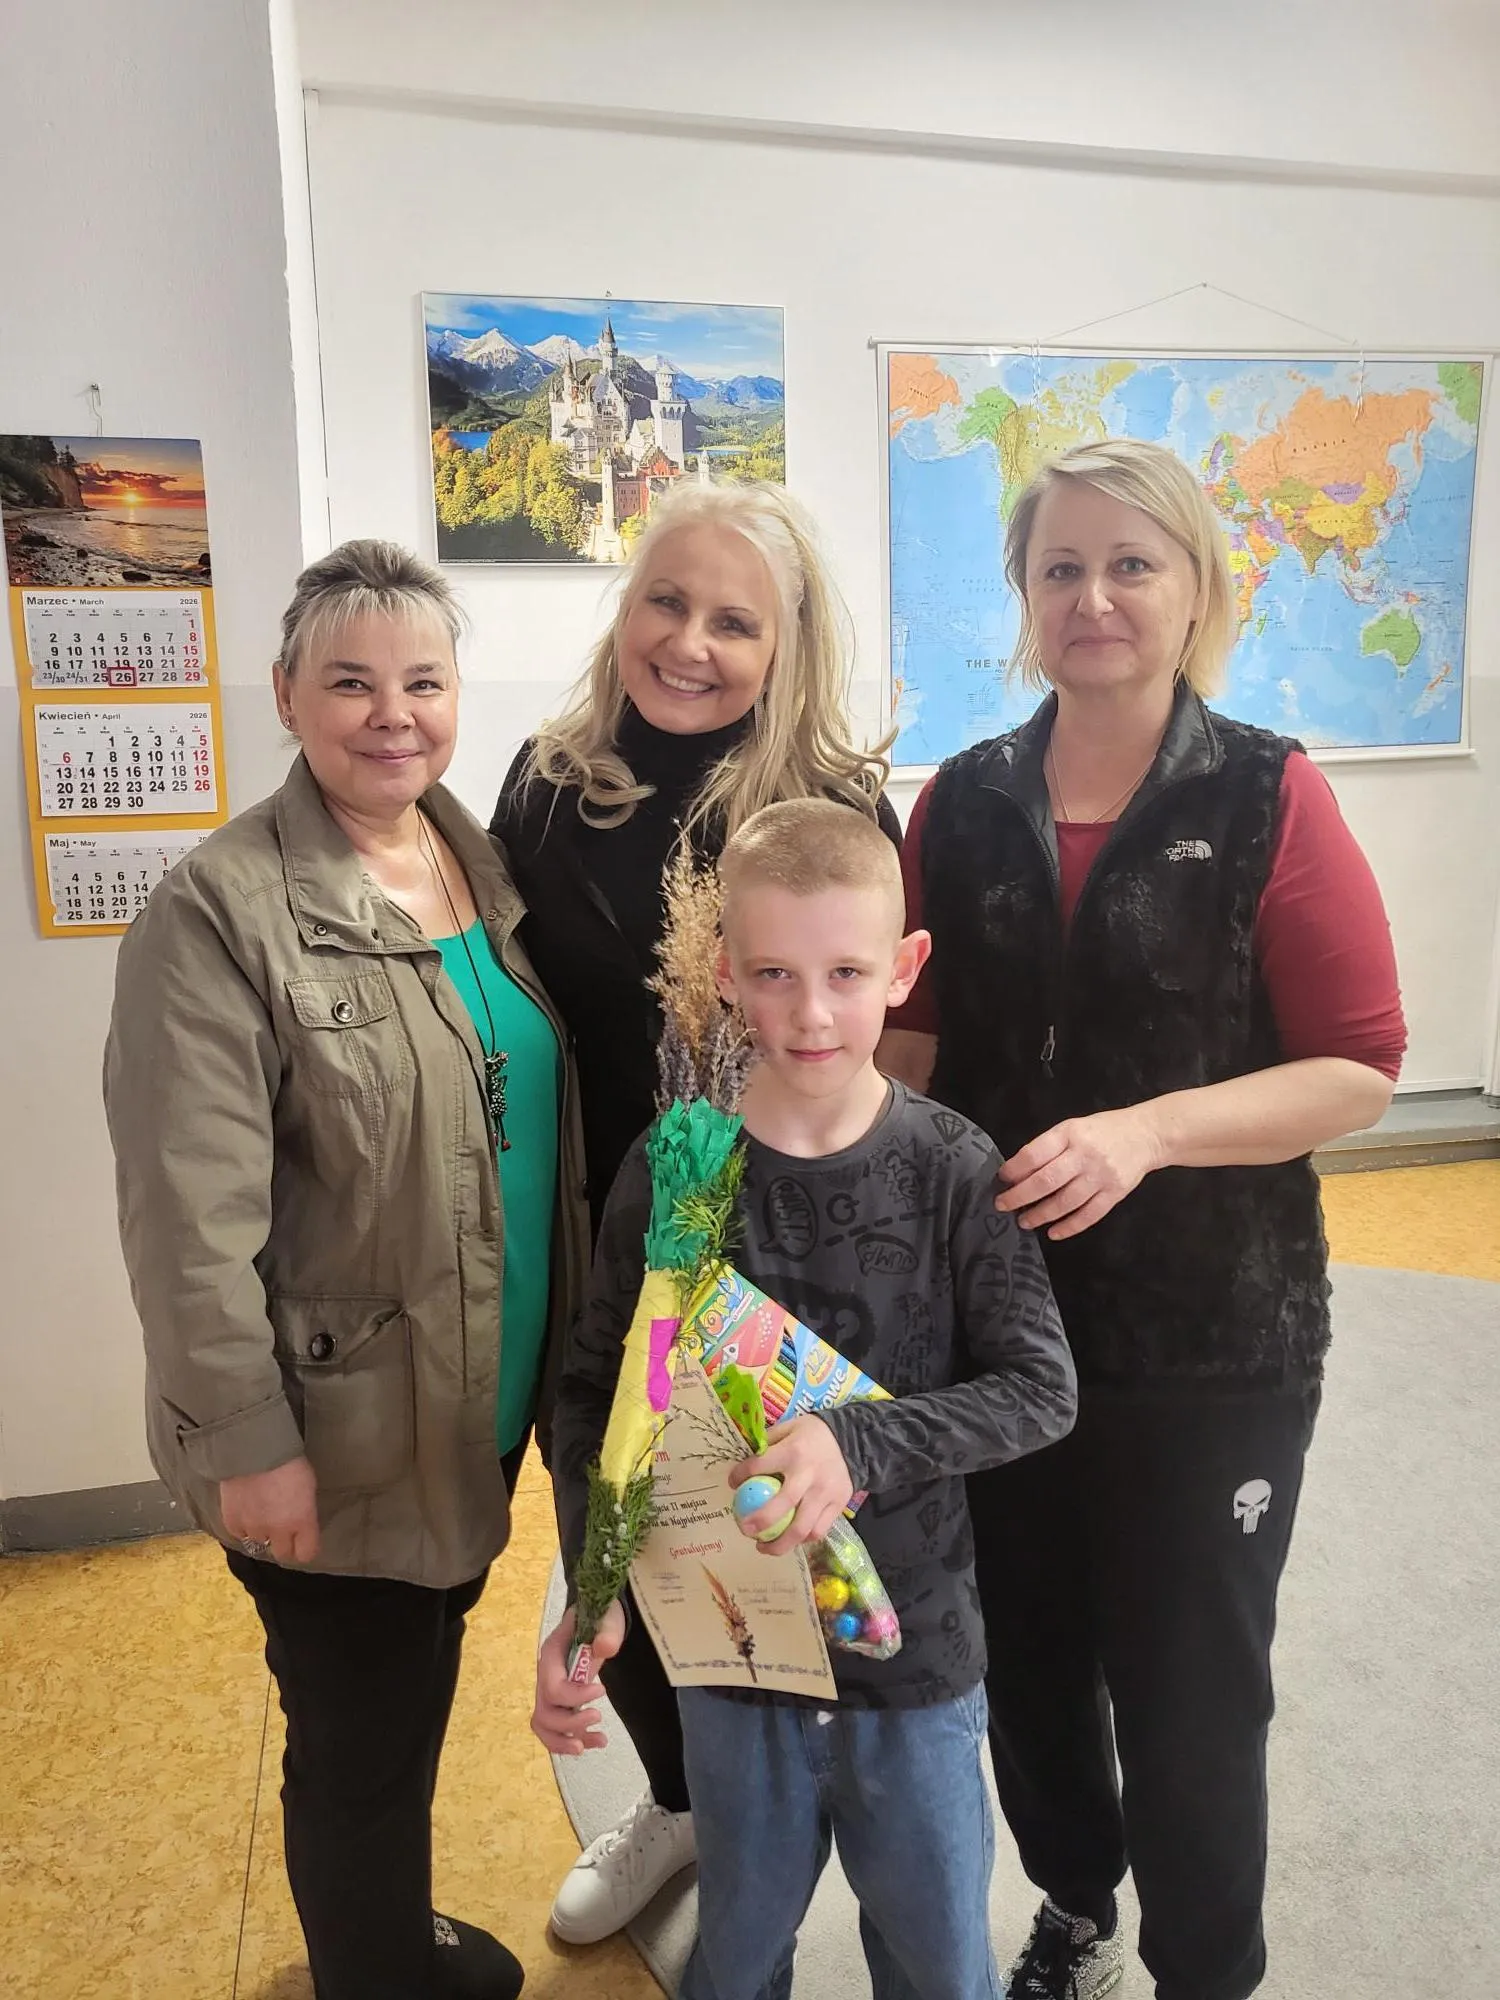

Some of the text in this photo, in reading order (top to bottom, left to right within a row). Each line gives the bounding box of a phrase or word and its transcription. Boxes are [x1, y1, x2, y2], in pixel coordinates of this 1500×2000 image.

[27, 597, 68, 605] Marzec
[188, 619, 194, 628] 1
[50, 632, 197, 643] 2 3 4 5 6 7 8
[51, 645, 198, 656] 9 10 11 12 13 14 15
[44, 659, 199, 669] 16 17 18 19 20 21 22
[966, 660, 991, 668] THE
[66, 671, 88, 684] 24/31
[93, 673, 108, 682] 25
[115, 672, 131, 682] 26
[139, 672, 154, 682] 27
[162, 672, 177, 682] 28
[185, 672, 200, 681] 29
[39, 711, 91, 720] Kwiecień
[102, 712, 120, 720] April
[108, 736, 114, 747] 1
[131, 736, 139, 747] 2
[154, 735, 162, 746] 3
[177, 735, 184, 746] 4
[200, 735, 207, 746] 5
[62, 750, 208, 763] 6 7 8 9 10 11 12
[56, 765, 209, 778] 13 14 15 16 17 18 19
[57, 780, 210, 794] 20 21 22 23 24 25 26
[58, 797, 143, 809] 27 28 29 30
[50, 839, 69, 848] Maj
[1165, 847, 1194, 855] ORTH
[162, 857, 167, 866] 1
[72, 873, 79, 882] 4
[94, 872, 102, 881] 5
[118, 872, 125, 880] 6
[140, 870, 147, 879] 7
[65, 883, 148, 895] 11 12 13 14
[66, 896, 148, 907] 18 19 20 21
[67, 911, 83, 920] 25
[90, 910, 105, 919] 26
[113, 909, 128, 918] 27
[863, 1245, 912, 1270] JUMP
